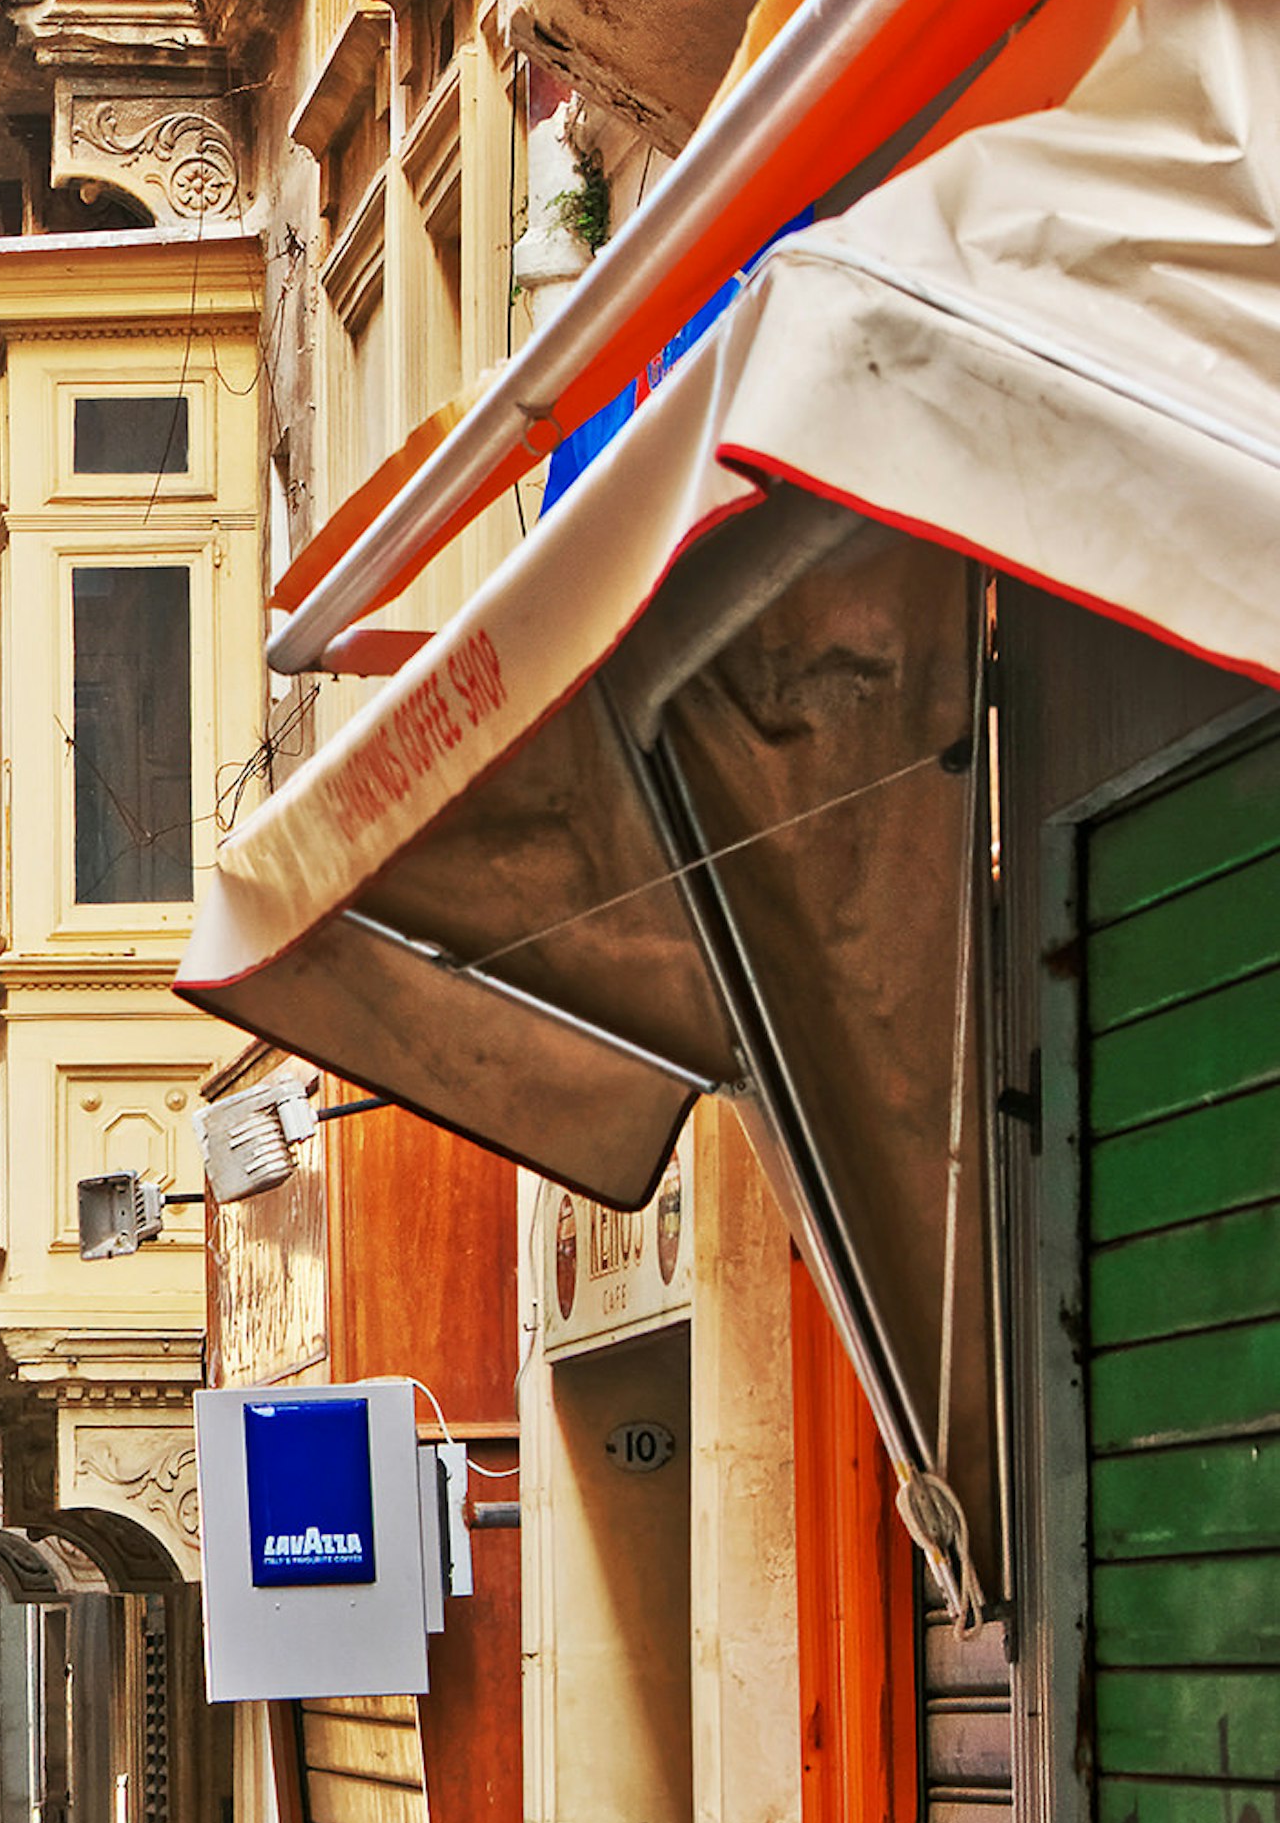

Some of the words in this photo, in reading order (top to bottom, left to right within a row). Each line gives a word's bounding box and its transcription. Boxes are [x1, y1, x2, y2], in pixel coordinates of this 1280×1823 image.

[393, 671, 463, 778] COFFEE
[448, 628, 509, 728] SHOP
[624, 1430, 657, 1463] 10
[263, 1526, 363, 1556] LAVAZZA
